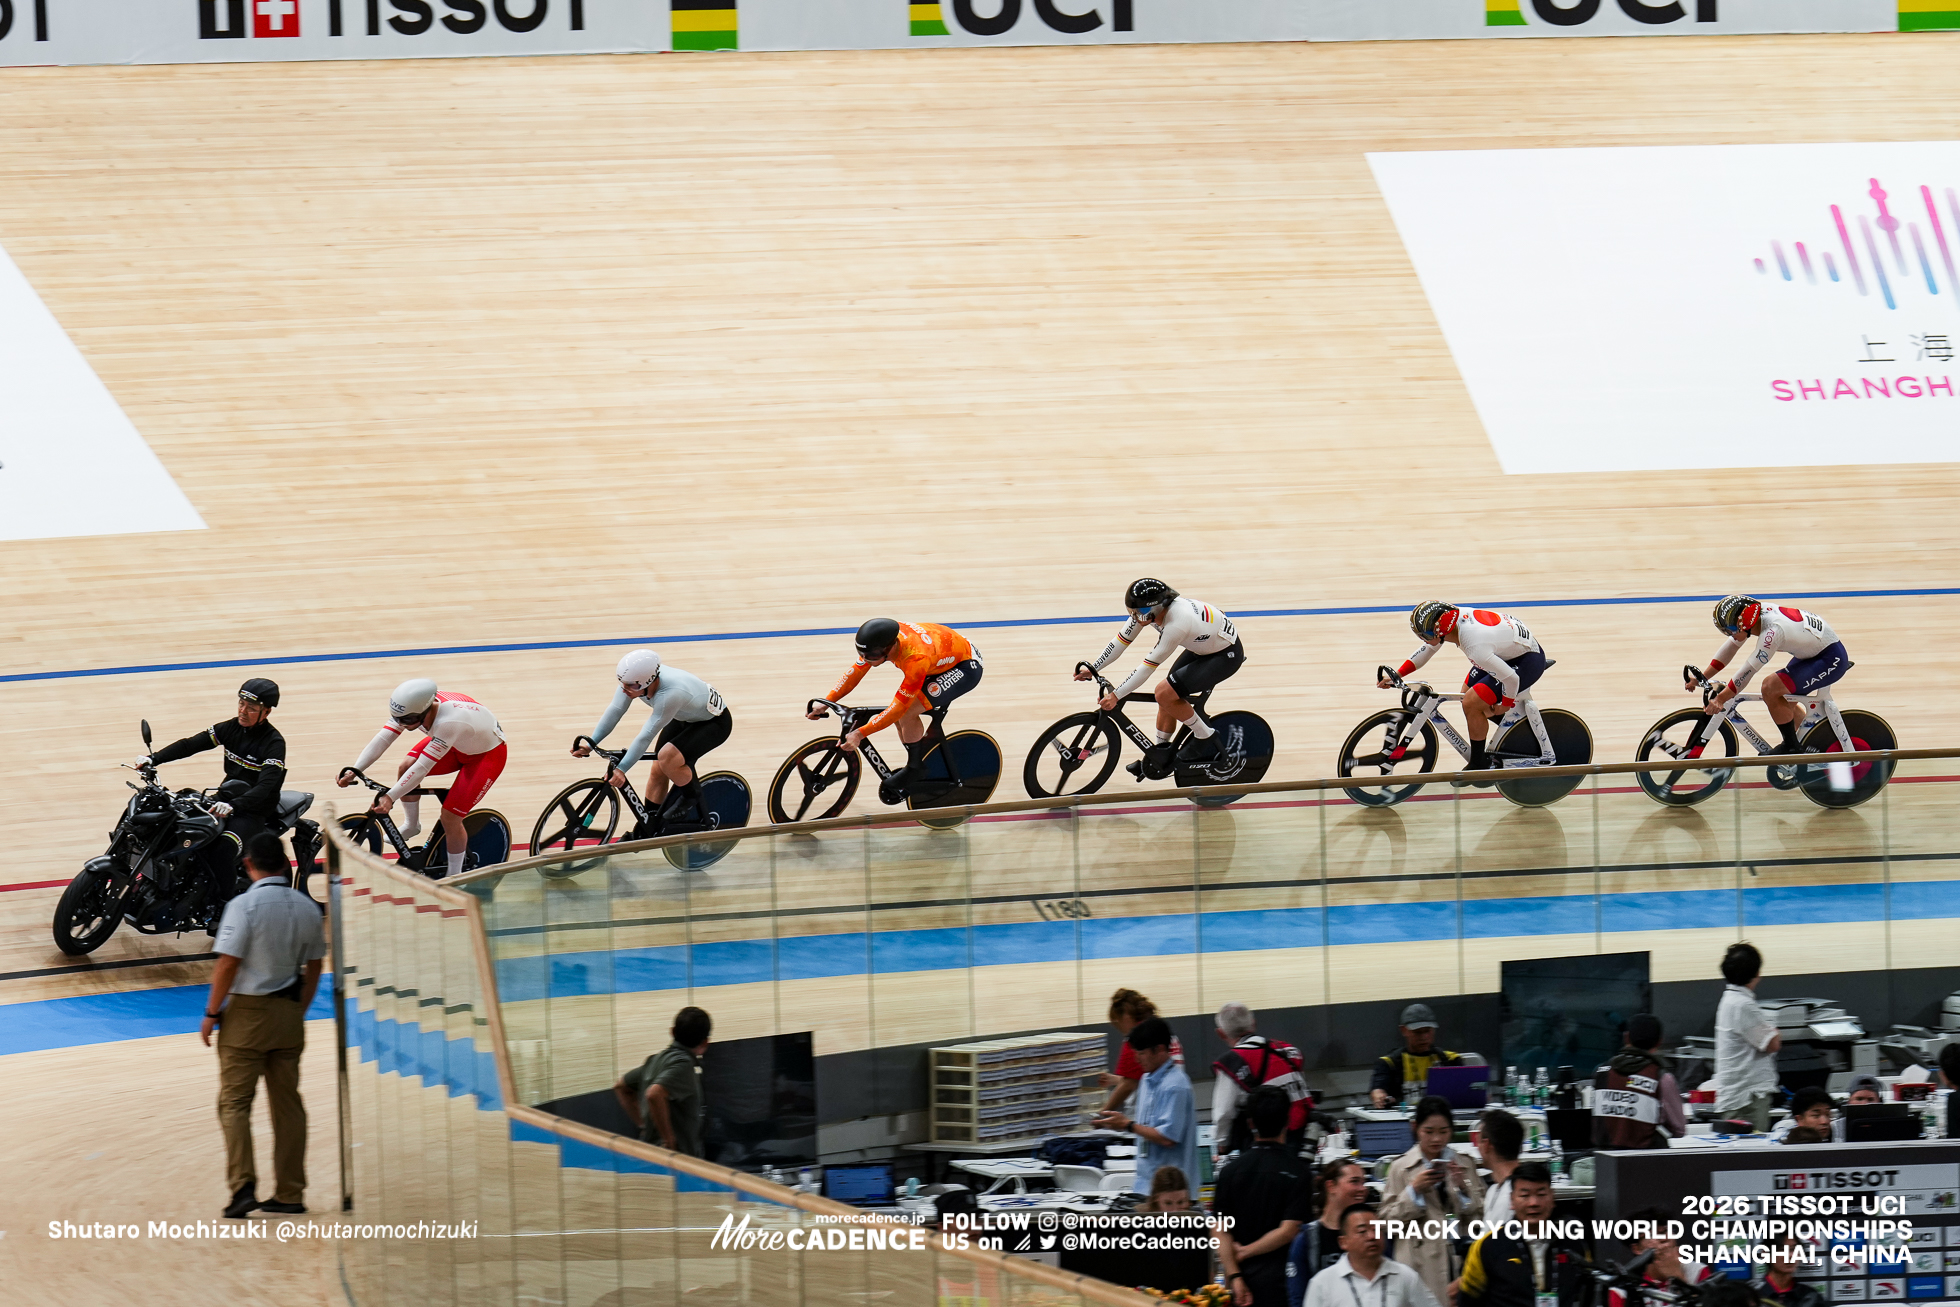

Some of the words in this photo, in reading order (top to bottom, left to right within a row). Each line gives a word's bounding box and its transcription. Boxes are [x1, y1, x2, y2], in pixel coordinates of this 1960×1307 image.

[1771, 376, 1960, 401] SHANGH
[1803, 657, 1841, 689] JAPAN
[871, 702, 897, 725] Rabobank
[1125, 724, 1153, 749] FES
[1443, 725, 1469, 752] TORAYCA
[400, 771, 415, 787] POLSKA
[624, 785, 649, 824] KOGA
[1810, 1170, 1900, 1189] TISSOT
